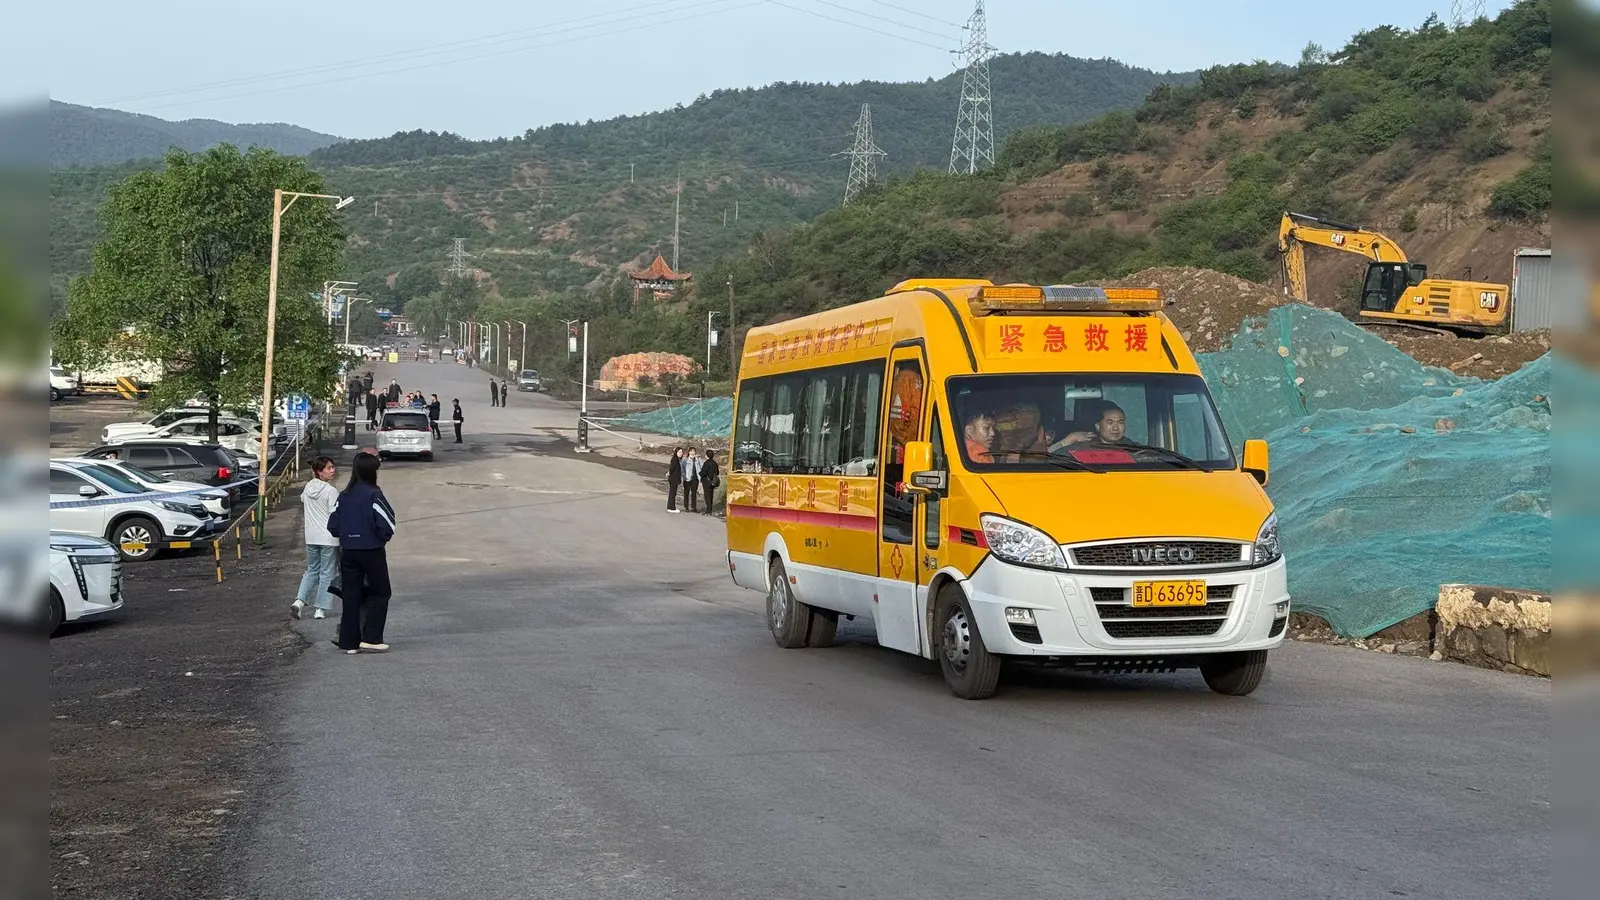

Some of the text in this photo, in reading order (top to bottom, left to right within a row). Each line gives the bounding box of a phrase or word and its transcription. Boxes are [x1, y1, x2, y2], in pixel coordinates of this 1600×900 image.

[1330, 233, 1345, 244] CAT
[1412, 296, 1423, 304] CAT
[1480, 292, 1497, 308] CAT
[999, 323, 1149, 353] 紧急救援
[292, 395, 303, 410] P
[1132, 547, 1194, 562] IVECO
